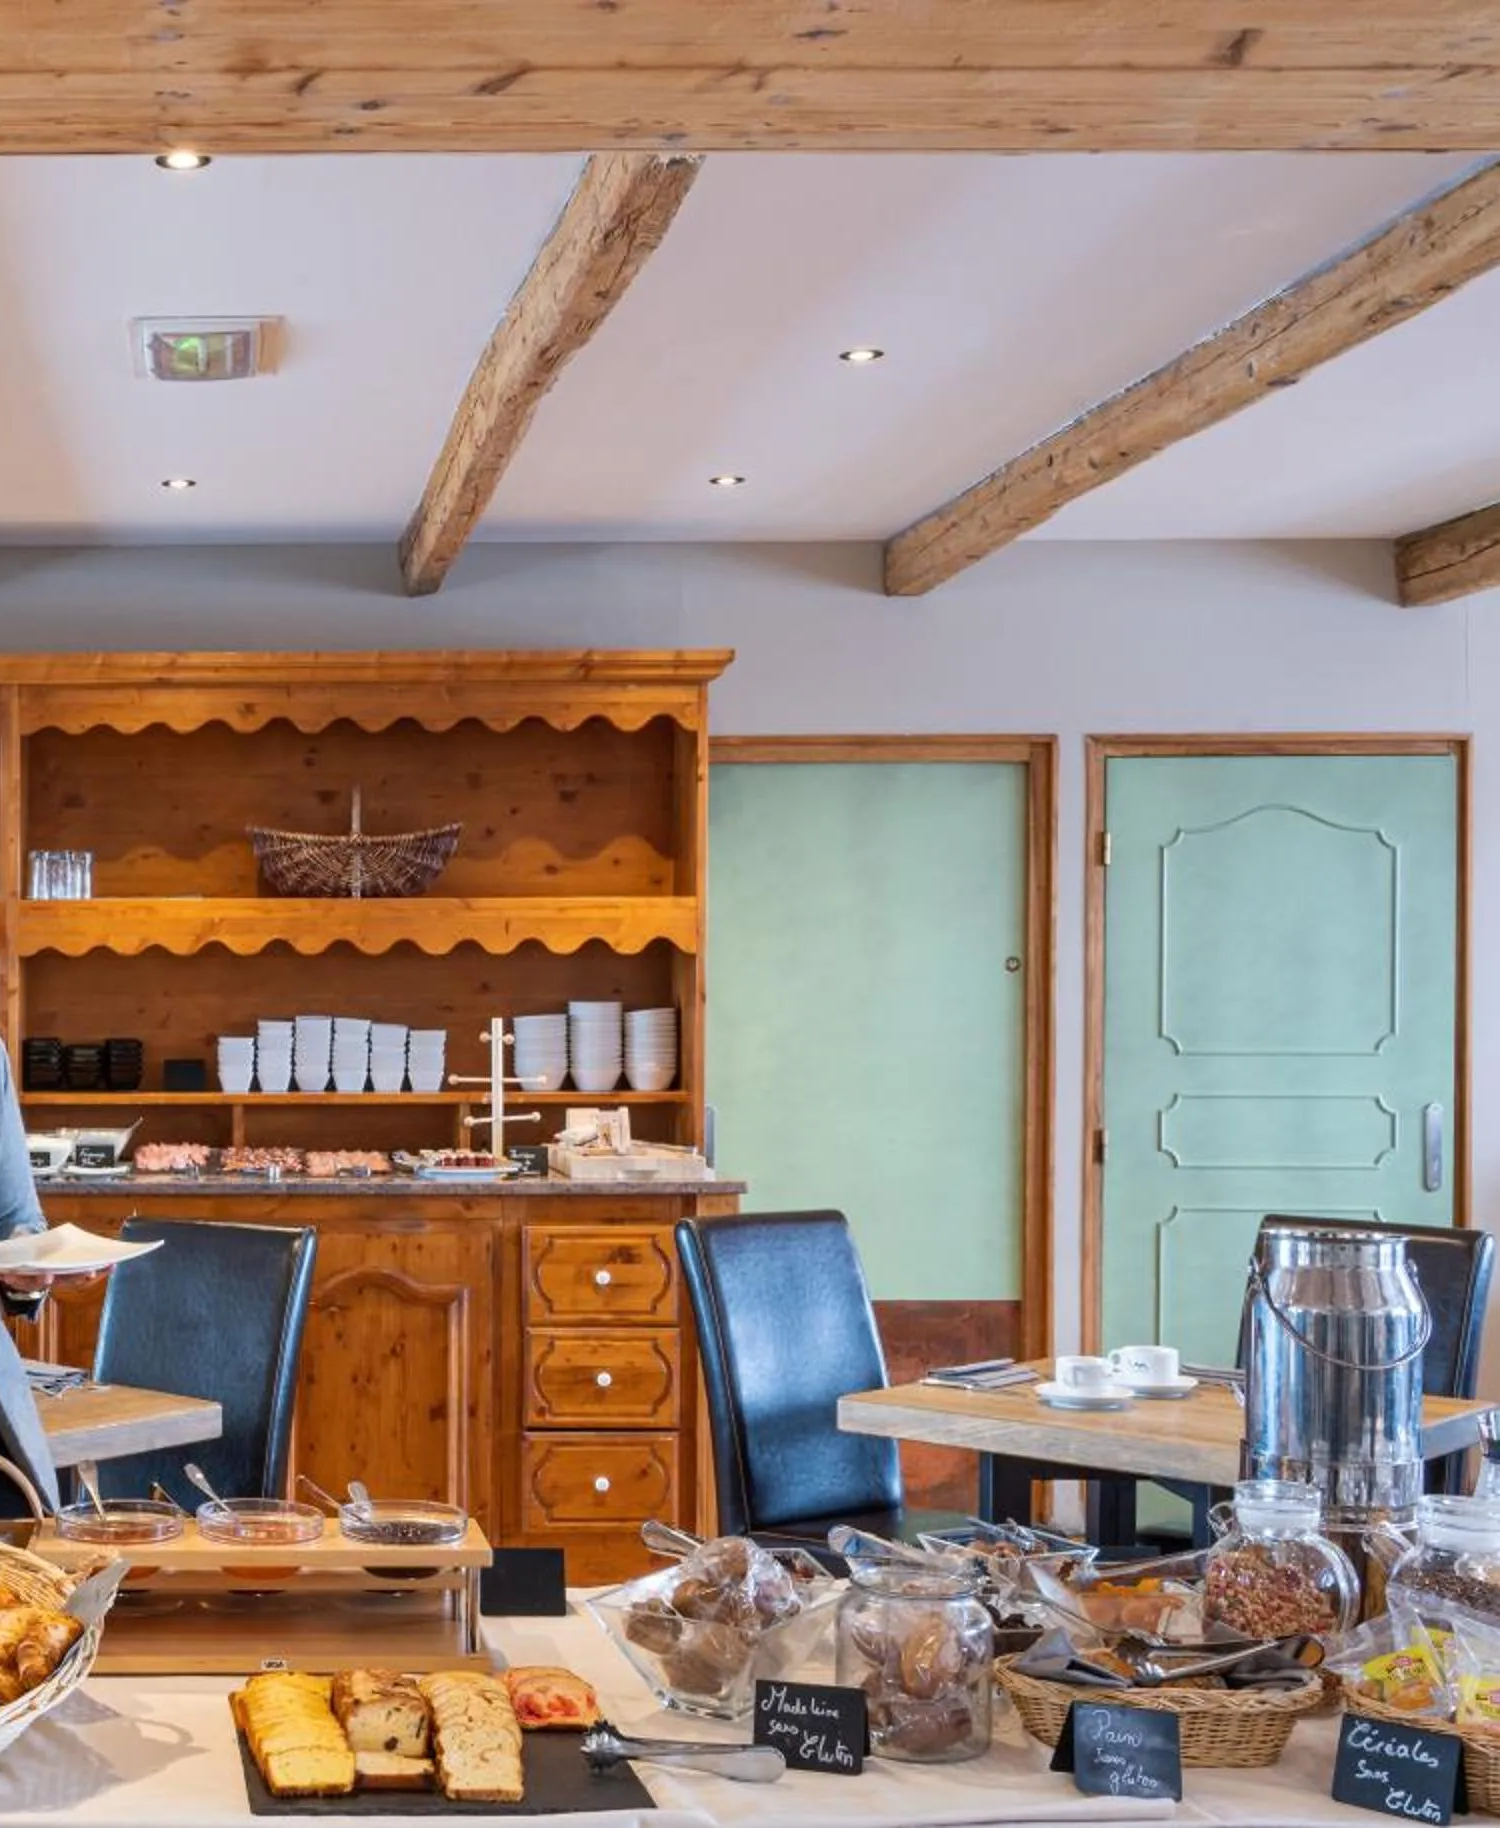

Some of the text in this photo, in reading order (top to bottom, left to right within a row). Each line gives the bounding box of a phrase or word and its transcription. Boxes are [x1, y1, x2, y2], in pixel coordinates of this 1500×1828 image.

[761, 1685, 839, 1718] Madeleine
[1091, 1709, 1143, 1747] Pain
[1347, 1720, 1439, 1768] Céréales
